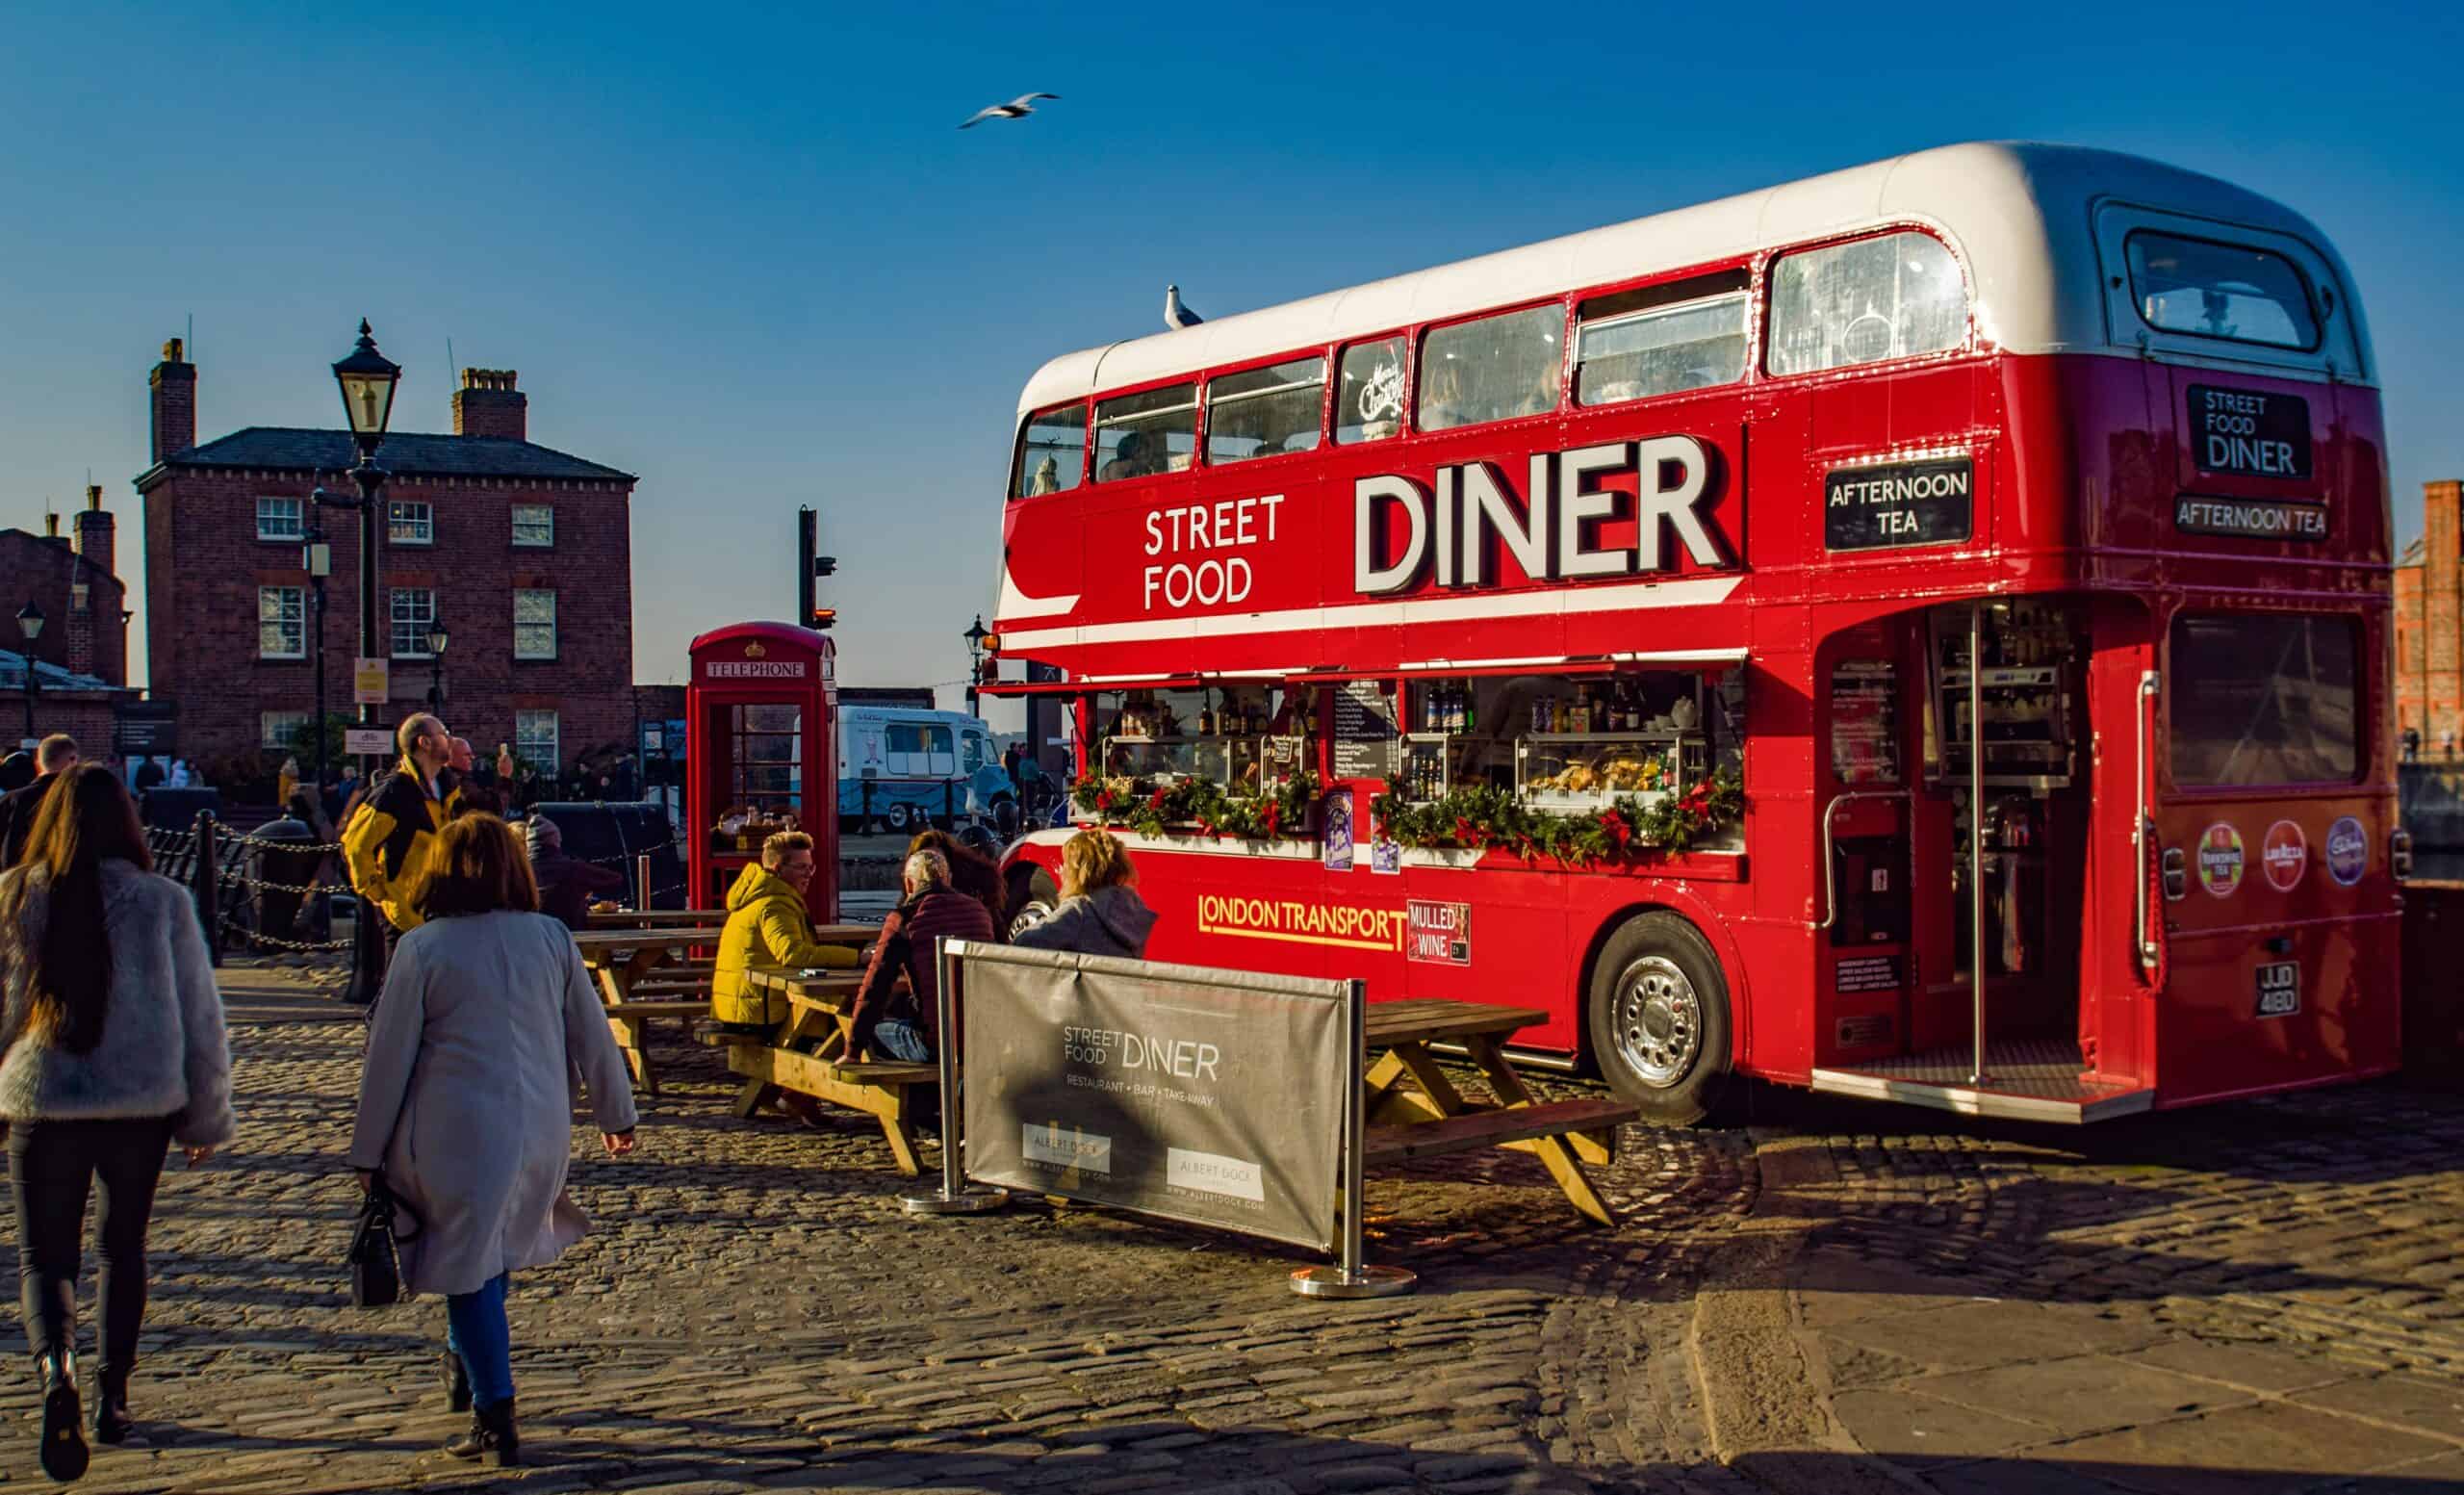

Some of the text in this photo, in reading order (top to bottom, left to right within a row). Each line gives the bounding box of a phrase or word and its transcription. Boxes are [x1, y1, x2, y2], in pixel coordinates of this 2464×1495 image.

[2205, 391, 2266, 414] STREET
[2206, 413, 2256, 434] FOOD
[2208, 434, 2297, 475] DINER
[1830, 472, 1967, 507] AFTERNOON
[1144, 494, 1285, 555] STREET
[1354, 434, 1729, 594] DINER
[1876, 509, 1919, 535] TEA
[2176, 501, 2326, 532] AFTERNOON TEA
[1144, 557, 1252, 610] FOOD
[710, 662, 803, 676] TELEPHONE
[1198, 894, 1408, 952] LONDON TRANSPORT
[1409, 904, 1455, 930] MULLED
[1417, 933, 1448, 957] WINE
[2261, 966, 2294, 989] JJD
[1064, 1025, 1123, 1048] STREET
[1064, 1044, 1107, 1065] FOOD
[1121, 1033, 1219, 1082] DINER
[1066, 1073, 1125, 1093] RESTAURANT
[1133, 1083, 1155, 1097] BAR
[1180, 1160, 1217, 1176] ALBERT
